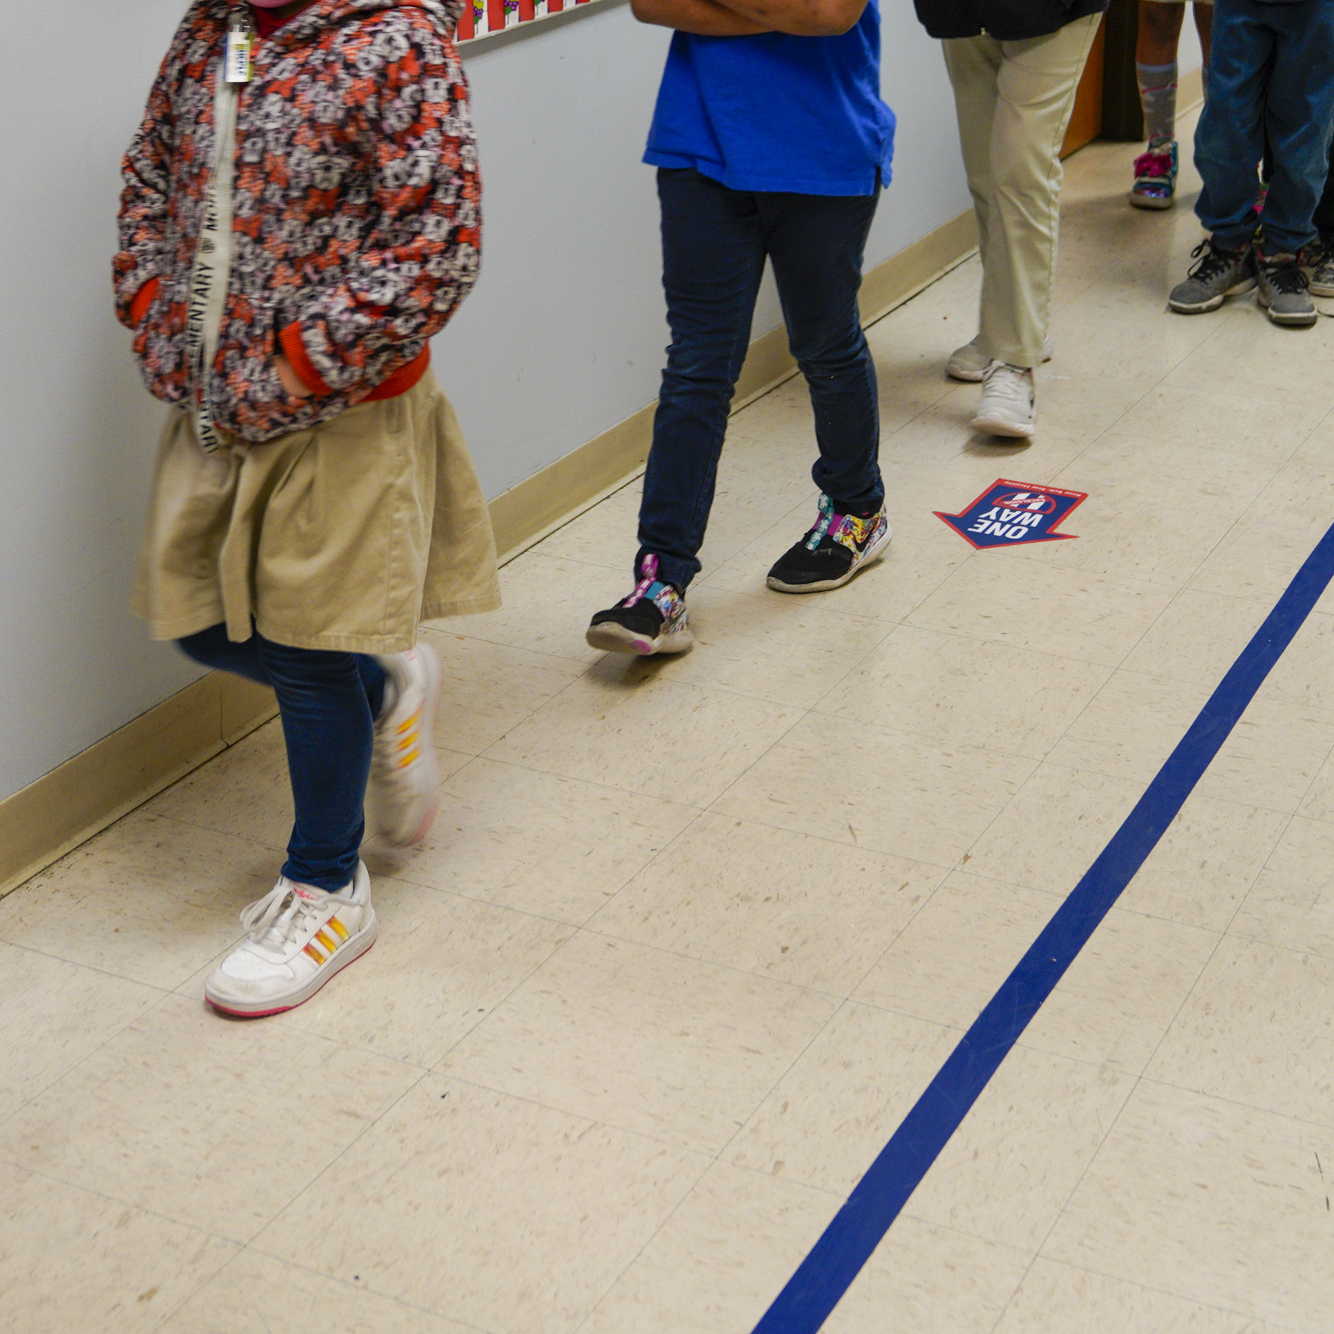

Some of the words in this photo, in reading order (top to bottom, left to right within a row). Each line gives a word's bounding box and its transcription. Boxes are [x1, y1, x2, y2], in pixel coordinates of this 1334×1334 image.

[1004, 479, 1026, 489] Healthy
[1028, 484, 1044, 492] Stay
[979, 507, 1043, 527] WAY
[967, 518, 1029, 540] ONE
